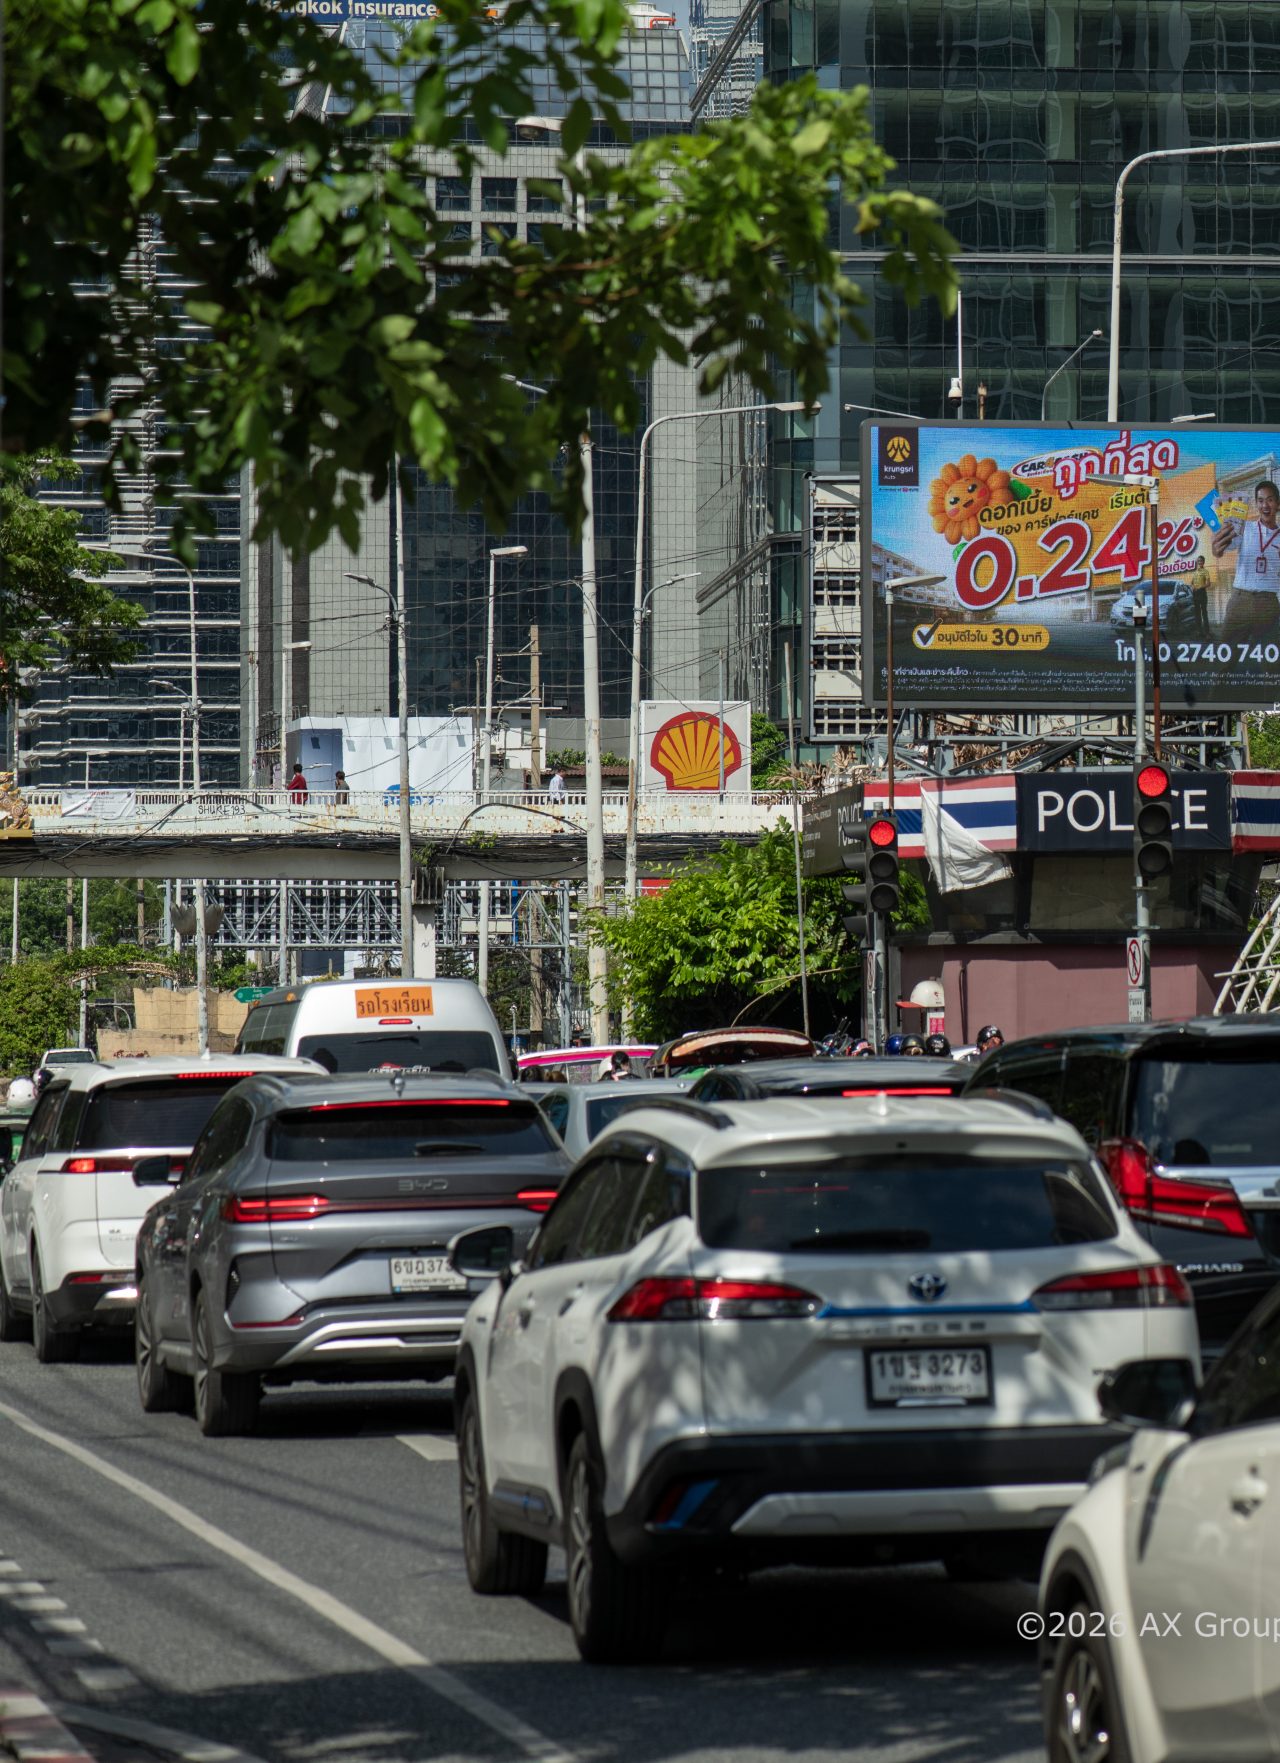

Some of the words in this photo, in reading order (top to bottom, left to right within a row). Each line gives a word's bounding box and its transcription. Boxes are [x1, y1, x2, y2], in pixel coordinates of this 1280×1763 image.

[349, 0, 437, 17] Insurance
[883, 465, 914, 475] krungsri
[1054, 430, 1180, 500] ถูกที่สด
[979, 489, 1053, 523] ดอกเบี้ย
[991, 628, 1020, 646] 30
[1021, 630, 1043, 643] นาที
[1177, 643, 1232, 663] 2740
[1036, 789, 1209, 833] POLE
[357, 990, 431, 1015] รถโรงเรียน
[398, 1178, 449, 1191] BYD
[1176, 1263, 1245, 1273] LPHARD
